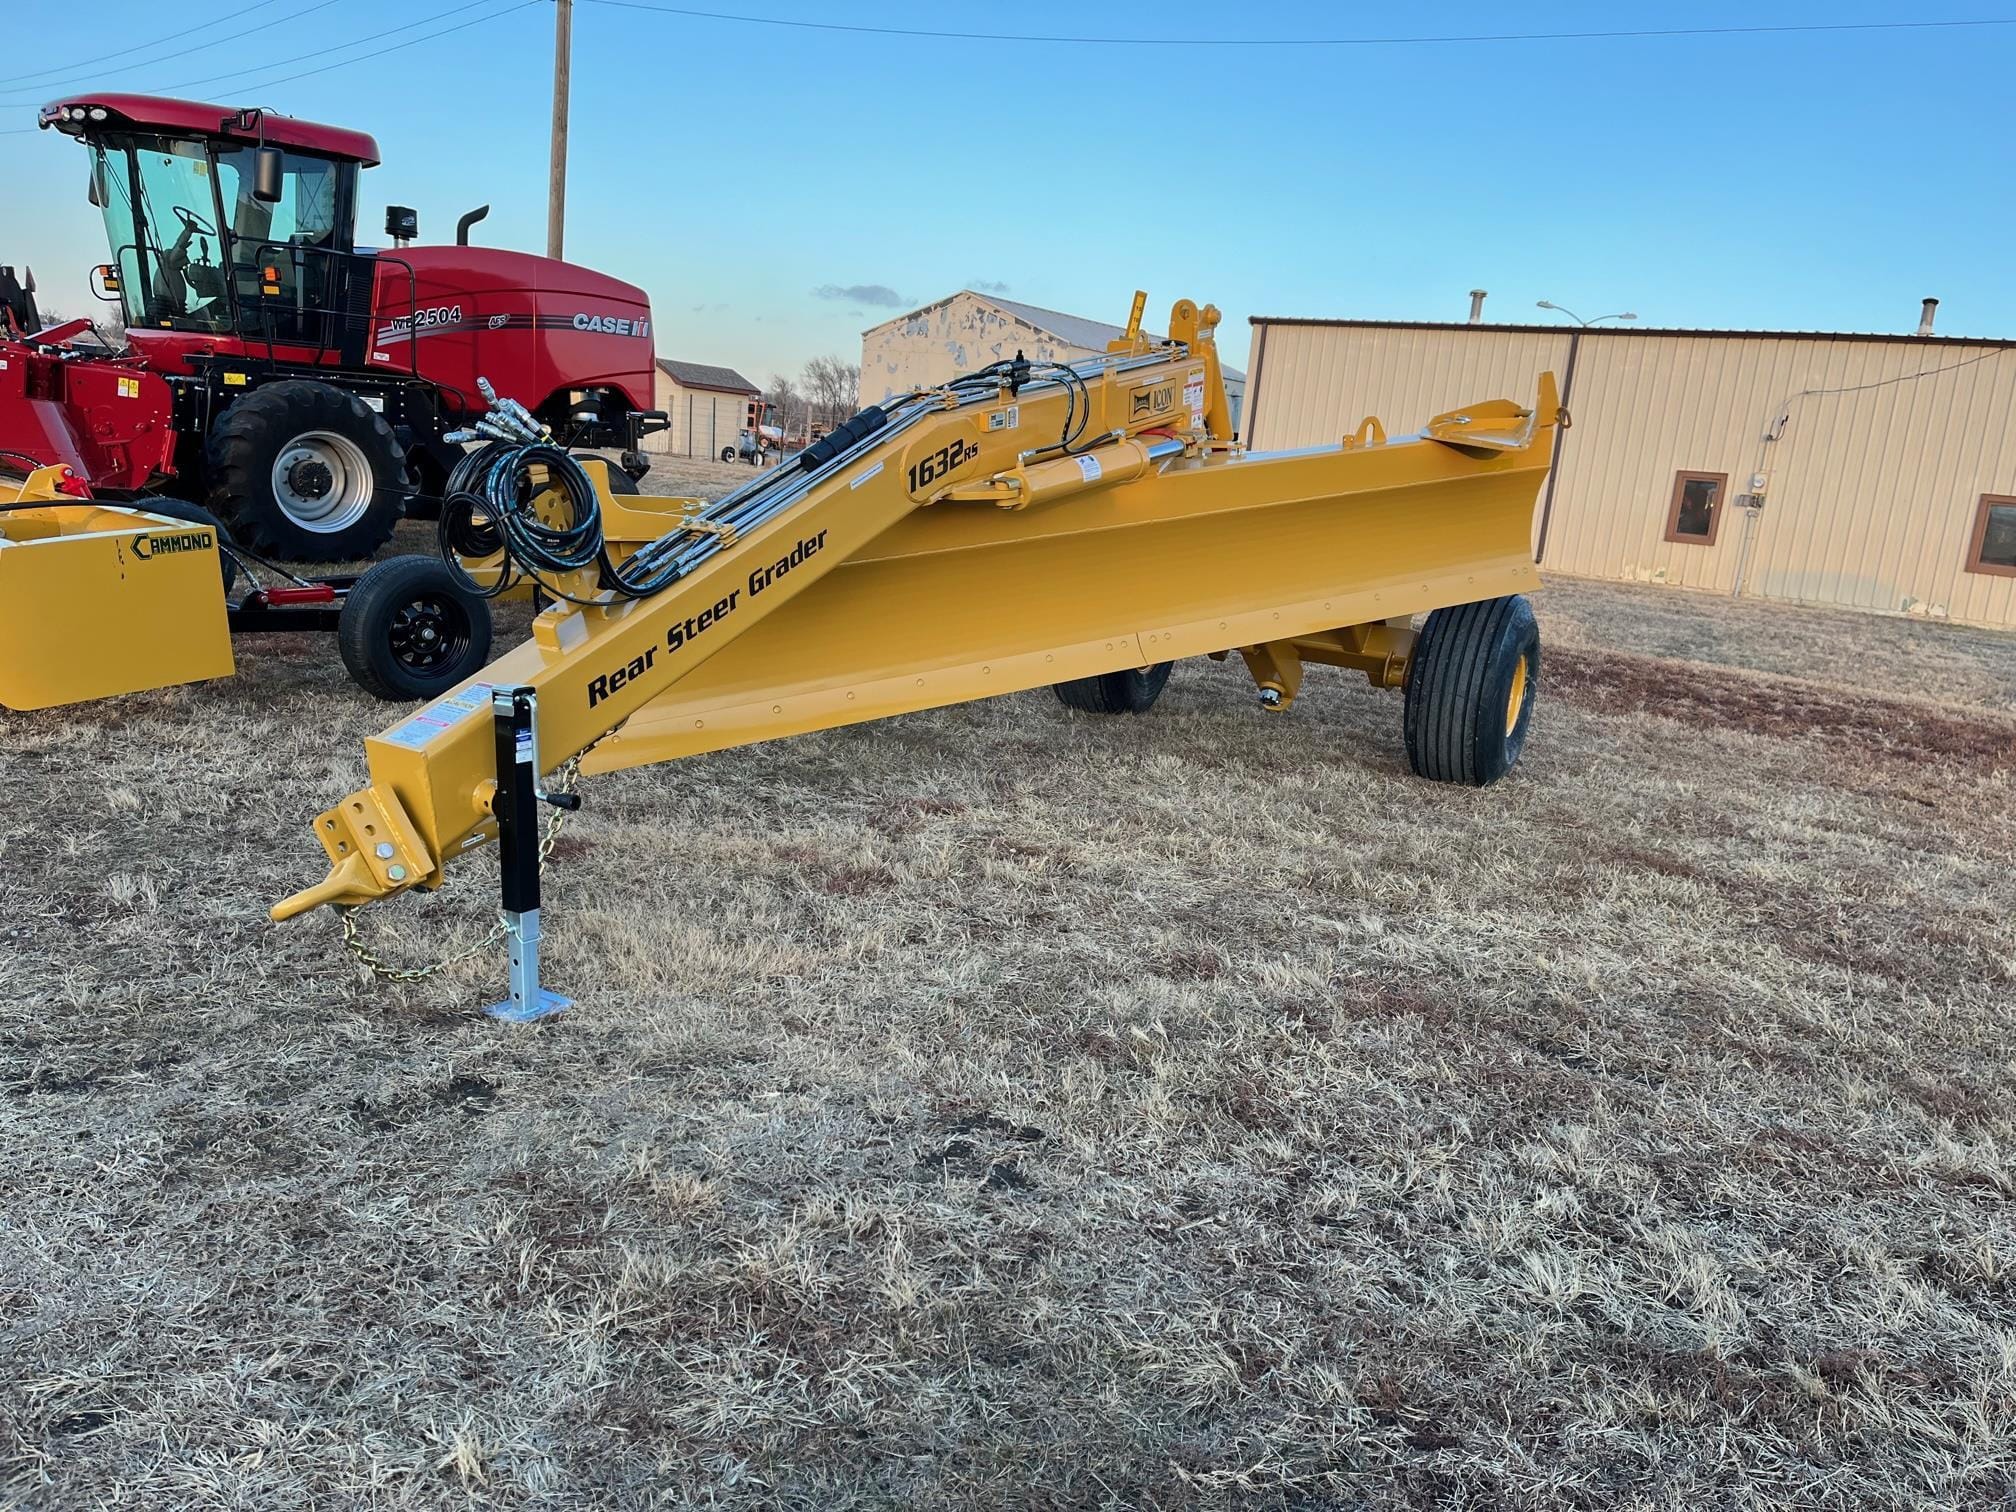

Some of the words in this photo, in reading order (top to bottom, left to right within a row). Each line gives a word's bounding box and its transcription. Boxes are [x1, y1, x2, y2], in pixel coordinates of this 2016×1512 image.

[573, 313, 630, 335] CASE
[1153, 387, 1173, 408] ICON
[130, 533, 213, 560] CAMMOND
[587, 645, 658, 709] Rear
[667, 588, 741, 654] Steer
[748, 529, 828, 597] Grader
